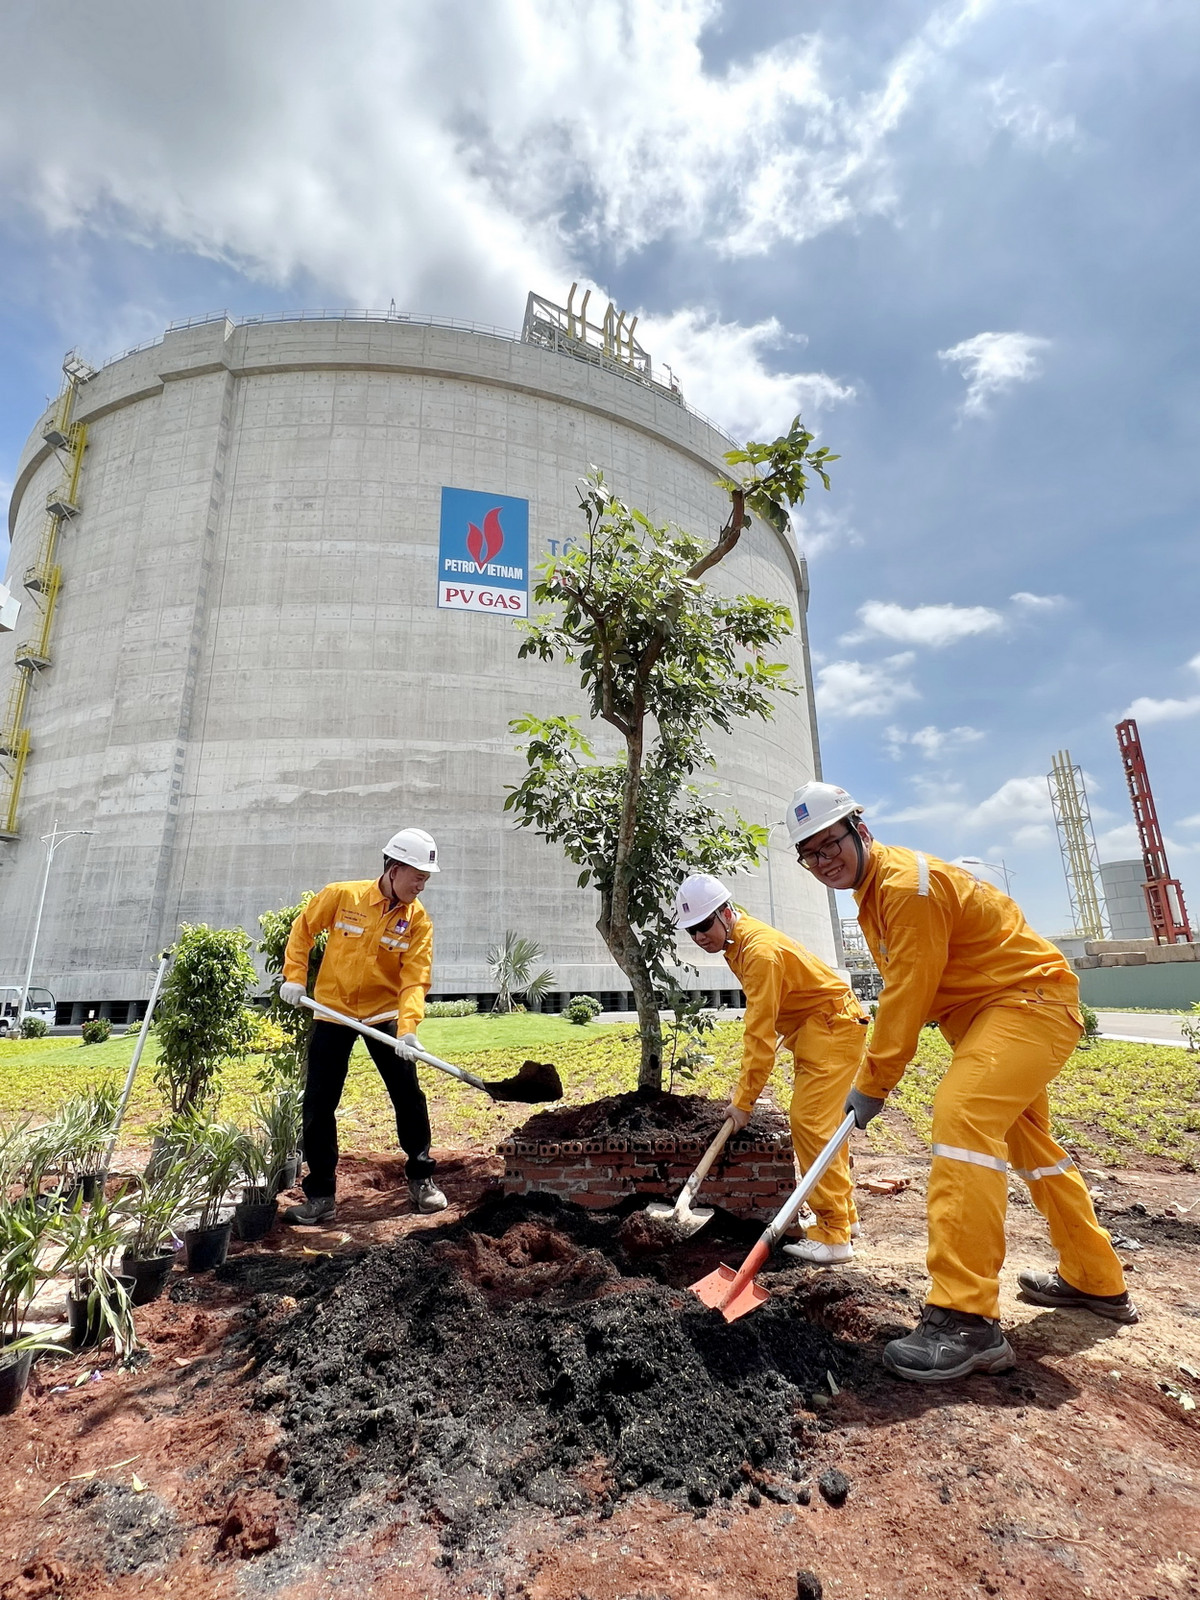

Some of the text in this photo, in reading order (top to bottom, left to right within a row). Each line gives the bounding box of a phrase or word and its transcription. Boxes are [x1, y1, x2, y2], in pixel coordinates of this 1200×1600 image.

[444, 558, 523, 581] PETROVIETNAM
[445, 587, 522, 610] PV GAS
